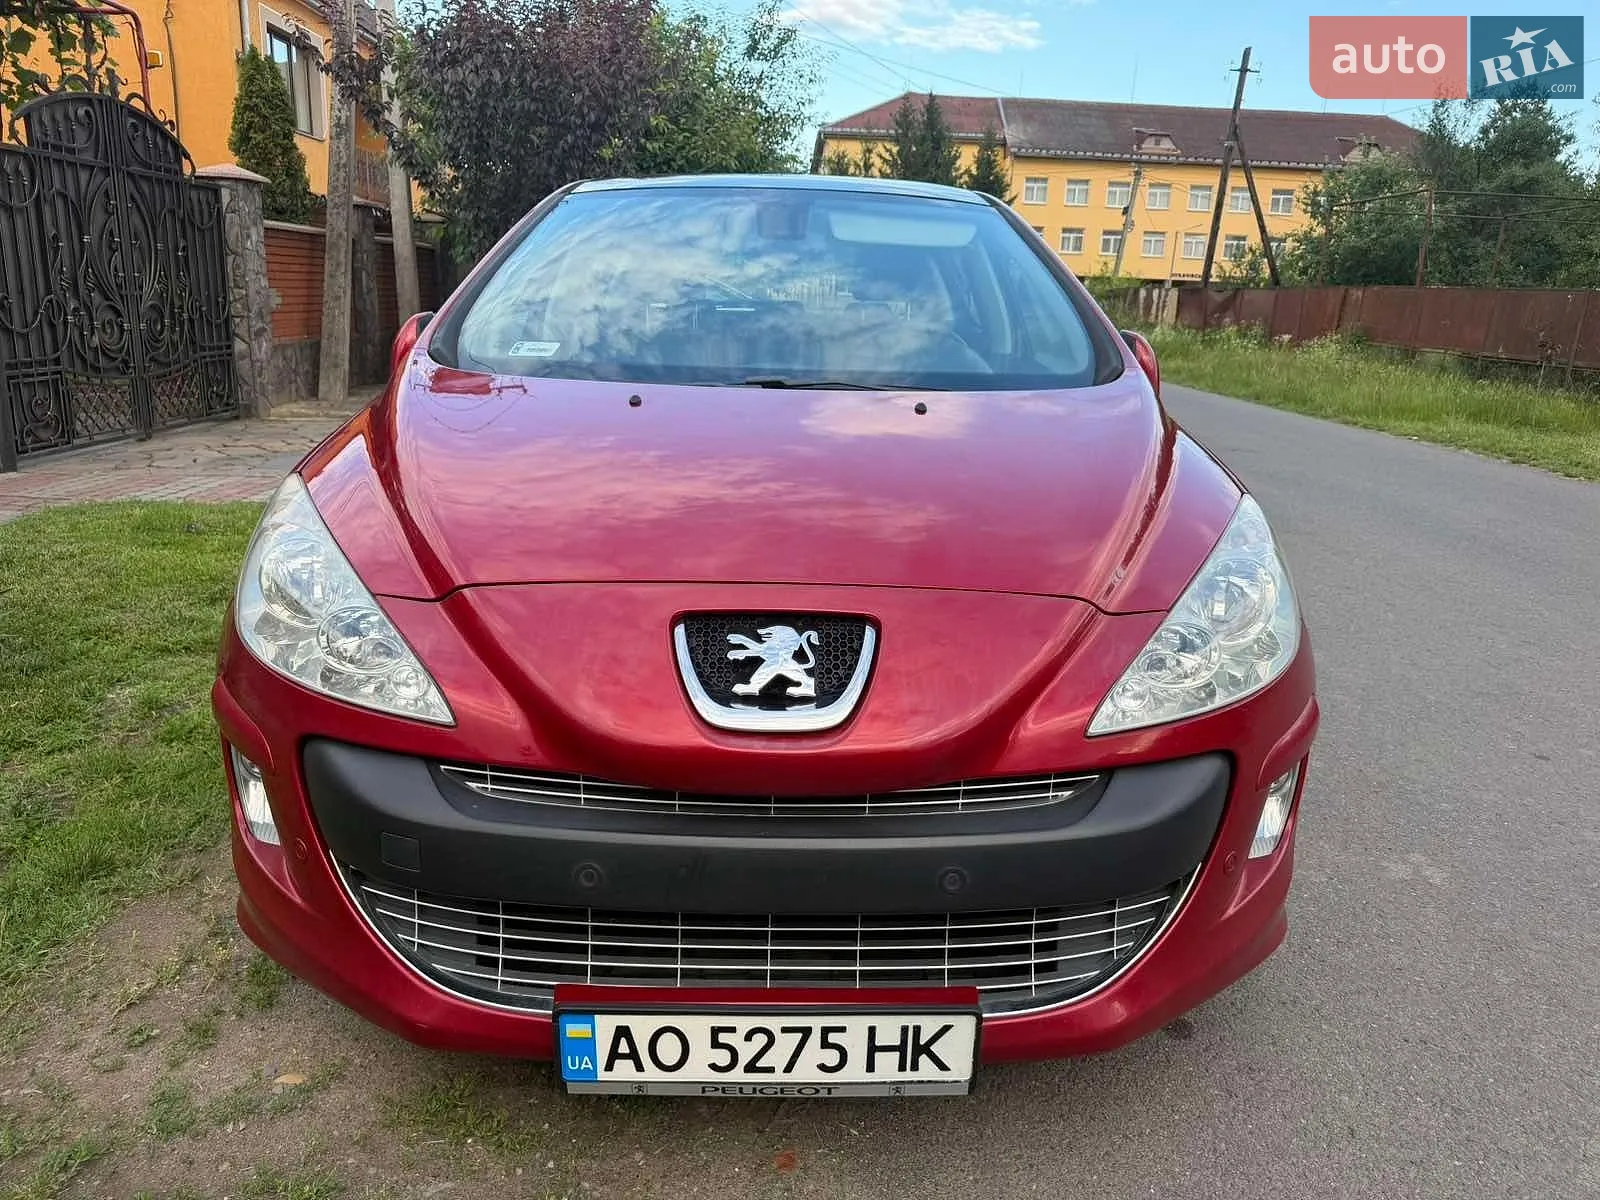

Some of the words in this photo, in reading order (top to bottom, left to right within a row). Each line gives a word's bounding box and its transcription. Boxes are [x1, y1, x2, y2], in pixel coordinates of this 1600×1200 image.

[603, 1024, 691, 1073] AO
[707, 1025, 848, 1074] 5275
[865, 1024, 955, 1073] HK
[567, 1055, 594, 1071] UA
[701, 1085, 841, 1096] PEUGEOT
